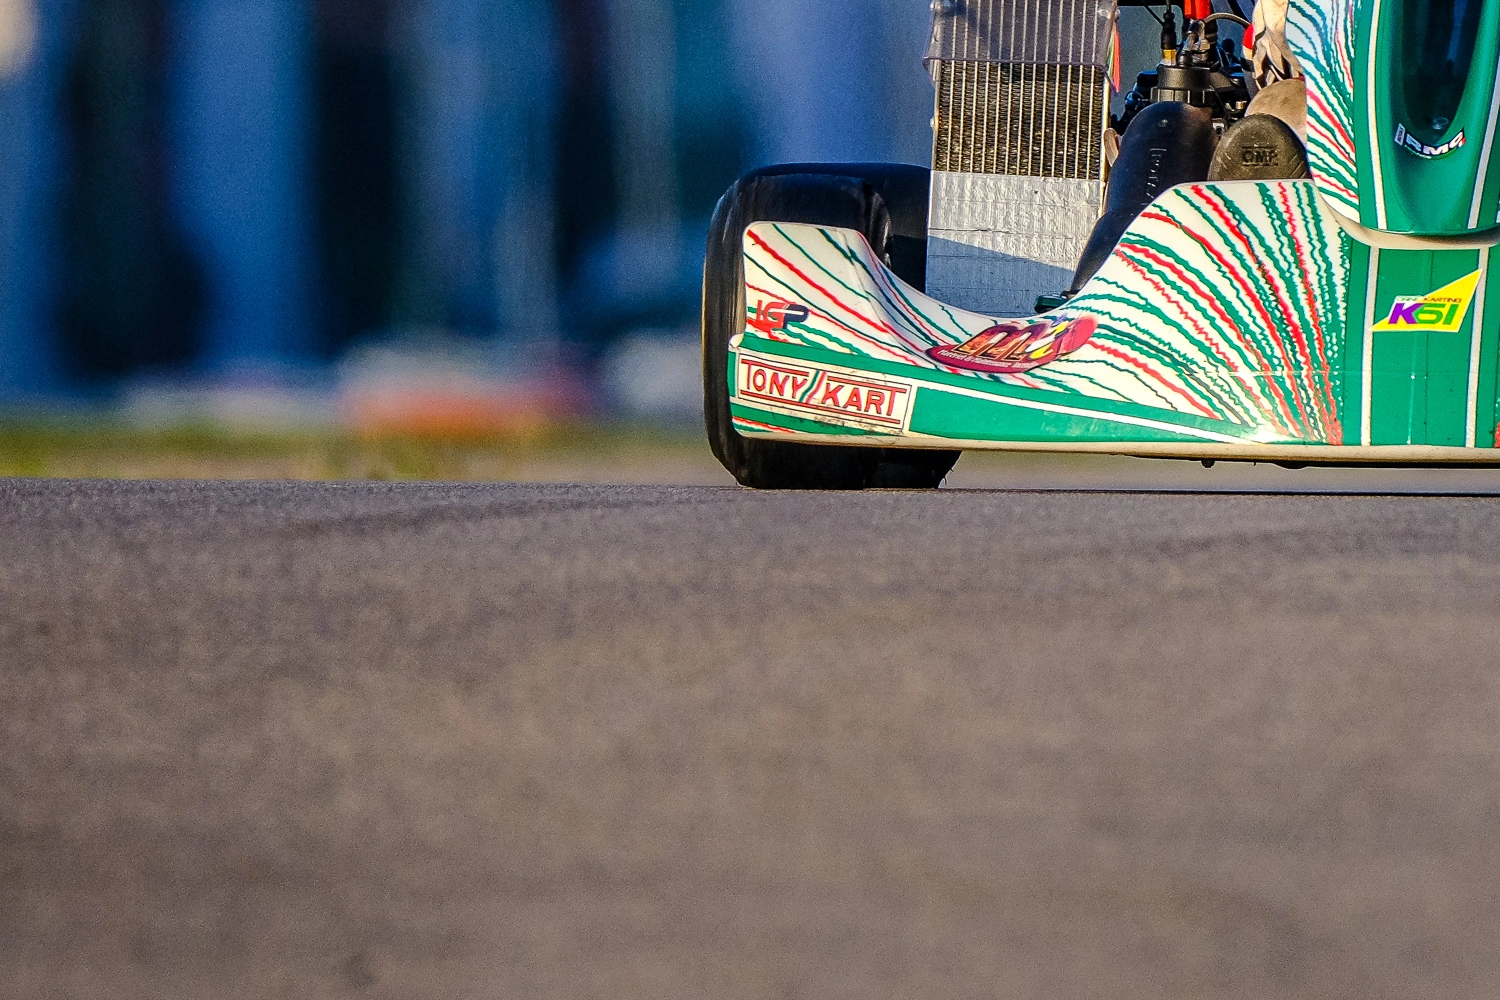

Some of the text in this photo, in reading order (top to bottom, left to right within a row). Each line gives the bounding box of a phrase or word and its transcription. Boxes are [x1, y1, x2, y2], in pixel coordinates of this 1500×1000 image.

[1241, 148, 1278, 165] OMP
[741, 358, 908, 417] TONY KART
